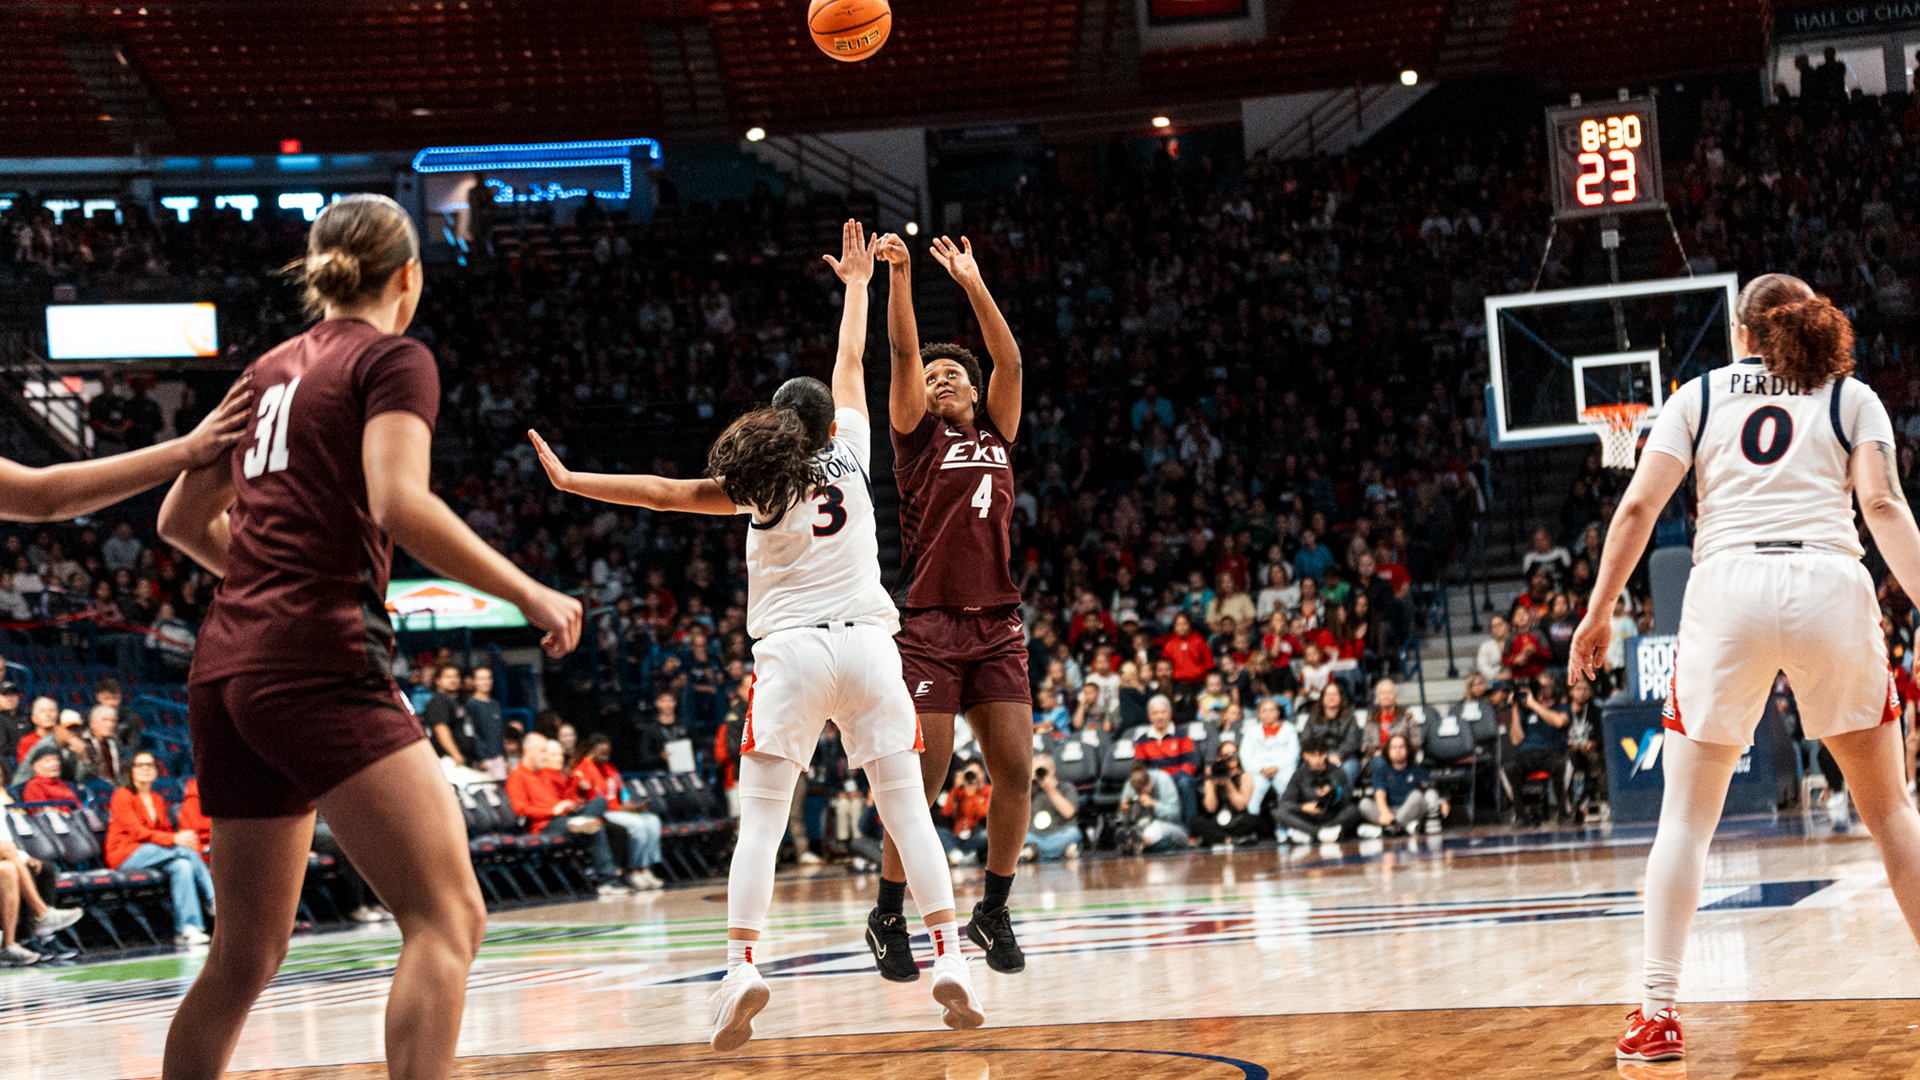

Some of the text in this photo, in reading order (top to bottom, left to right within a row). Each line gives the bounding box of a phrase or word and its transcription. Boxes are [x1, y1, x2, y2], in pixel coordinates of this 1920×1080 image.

[1794, 11, 1836, 29] HALL
[1846, 7, 1867, 24] OF
[1581, 115, 1641, 152] 8:30
[1576, 149, 1636, 206] 23
[1730, 374, 1813, 396] PERDU
[243, 375, 302, 480] 31
[1741, 405, 1794, 466] 0
[943, 441, 1007, 464] EKU
[812, 485, 847, 537] 3
[971, 474, 992, 518] 4
